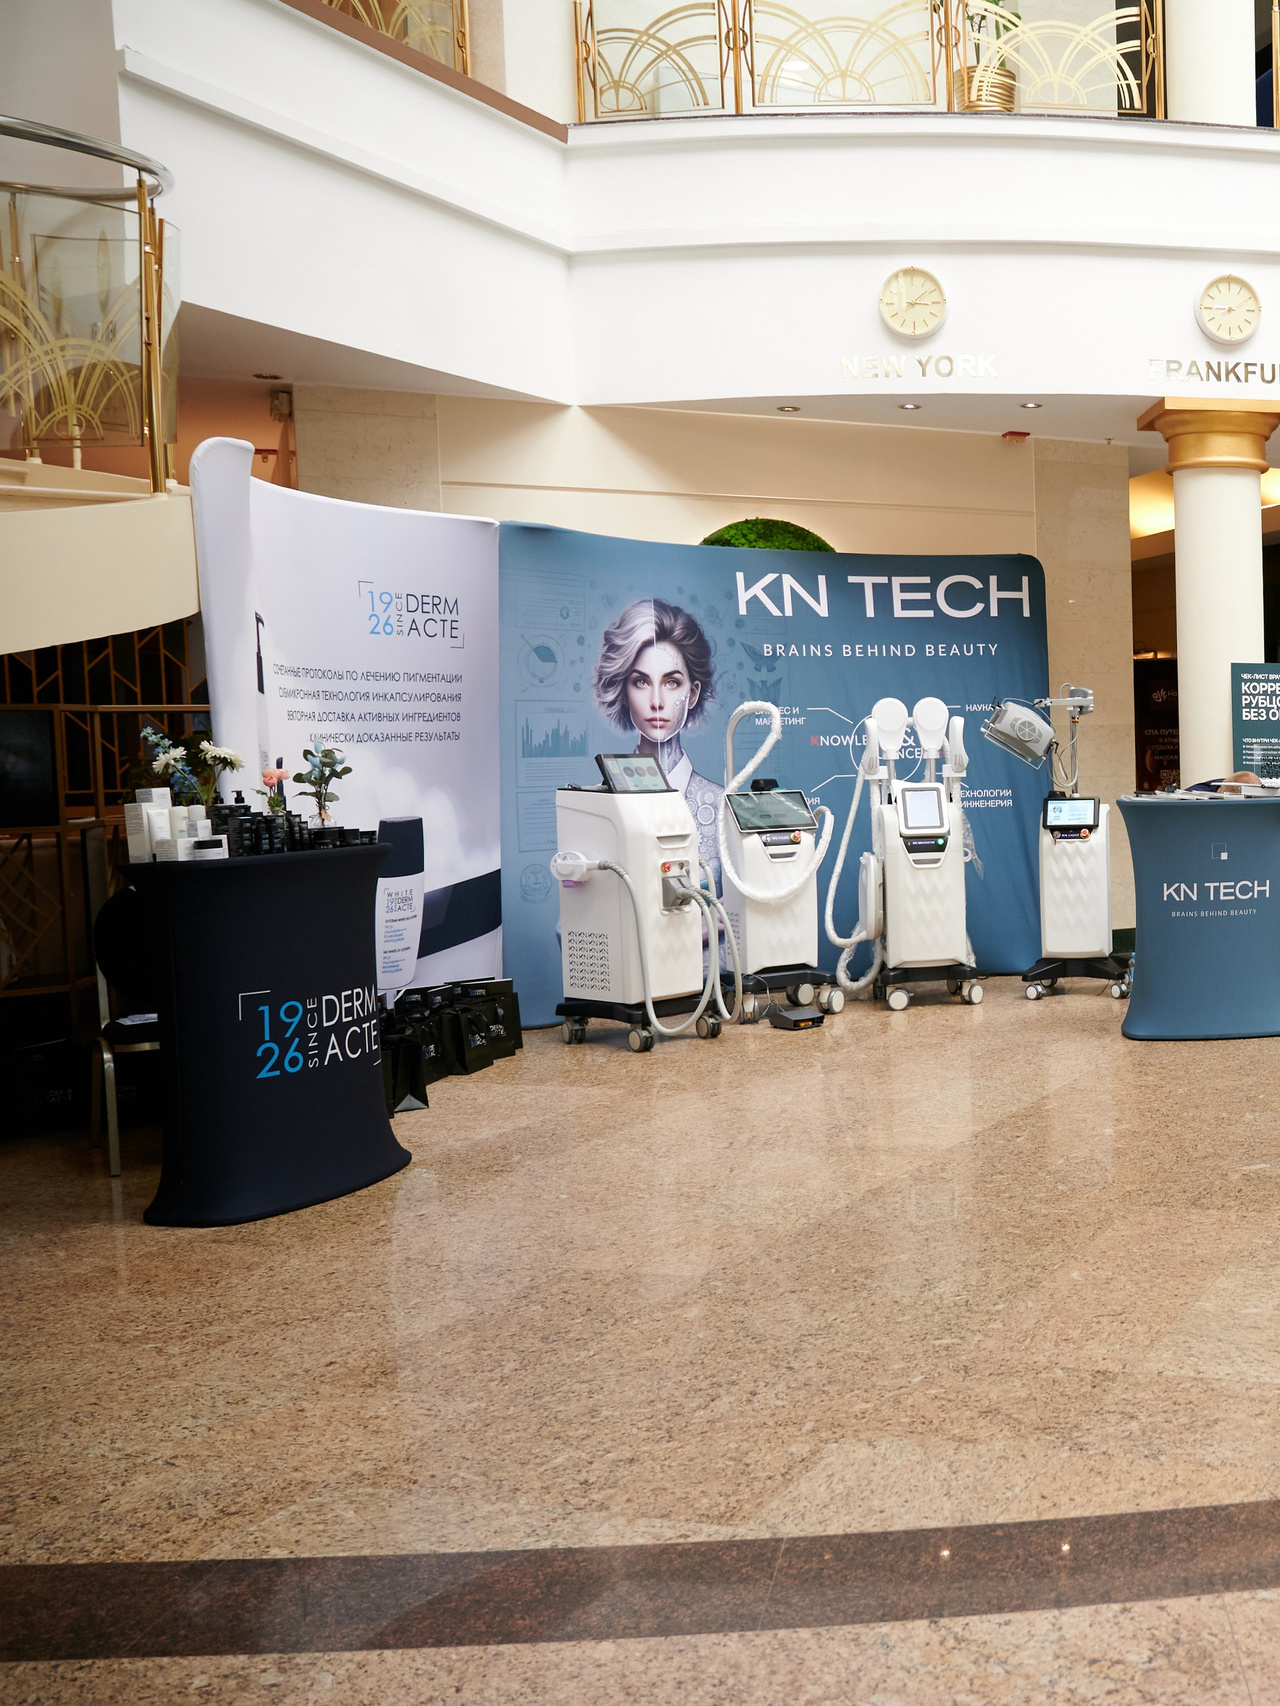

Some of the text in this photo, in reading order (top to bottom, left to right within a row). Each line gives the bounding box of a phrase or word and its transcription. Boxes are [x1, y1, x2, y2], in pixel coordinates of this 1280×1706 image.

[840, 354, 998, 378] NEW YORK
[368, 590, 393, 613] 19
[406, 593, 459, 616] DERM
[735, 571, 1031, 618] KN TECH
[368, 613, 394, 636] 26
[395, 592, 404, 636] SINCE
[407, 617, 459, 639] ACTE
[763, 643, 999, 657] BRAINS BEHIND BEAUTY
[301, 668, 345, 681] ПРОТОКОЛЫ
[345, 670, 358, 681] ПО
[360, 671, 401, 683] ЛЕЧЕНИЮ
[402, 672, 463, 684] ПИГМЕНТАЦИИ
[321, 690, 370, 702] ТЕХНОЛОГИЯ
[372, 691, 462, 703] ИНКАПСУЛИРОВАНИЯ
[287, 710, 461, 723] ВЕКТОРНАЯ ДОСТАВКА АКТИВНЫХ ИНГРЕДИЕНТОВ
[755, 717, 807, 726] МАРЕТИНГ
[1242, 708, 1267, 721] БЕЗ
[309, 731, 461, 743] КЛИНИЧЕСКИ ДОКАЗАННЫЕ РЕЗУЛЬТАТЫ
[960, 789, 1012, 798] ЕХНОЛОГИИ
[387, 888, 413, 898] WHITE
[1163, 880, 1270, 901] KN TECH
[397, 902, 413, 913] ACTE
[1230, 908, 1257, 916] BEAUTY
[322, 983, 377, 1027] DERM
[257, 1000, 304, 1041] 19
[306, 997, 319, 1068] SINCE
[324, 1019, 378, 1066] ACTE
[255, 1037, 304, 1079] 26
